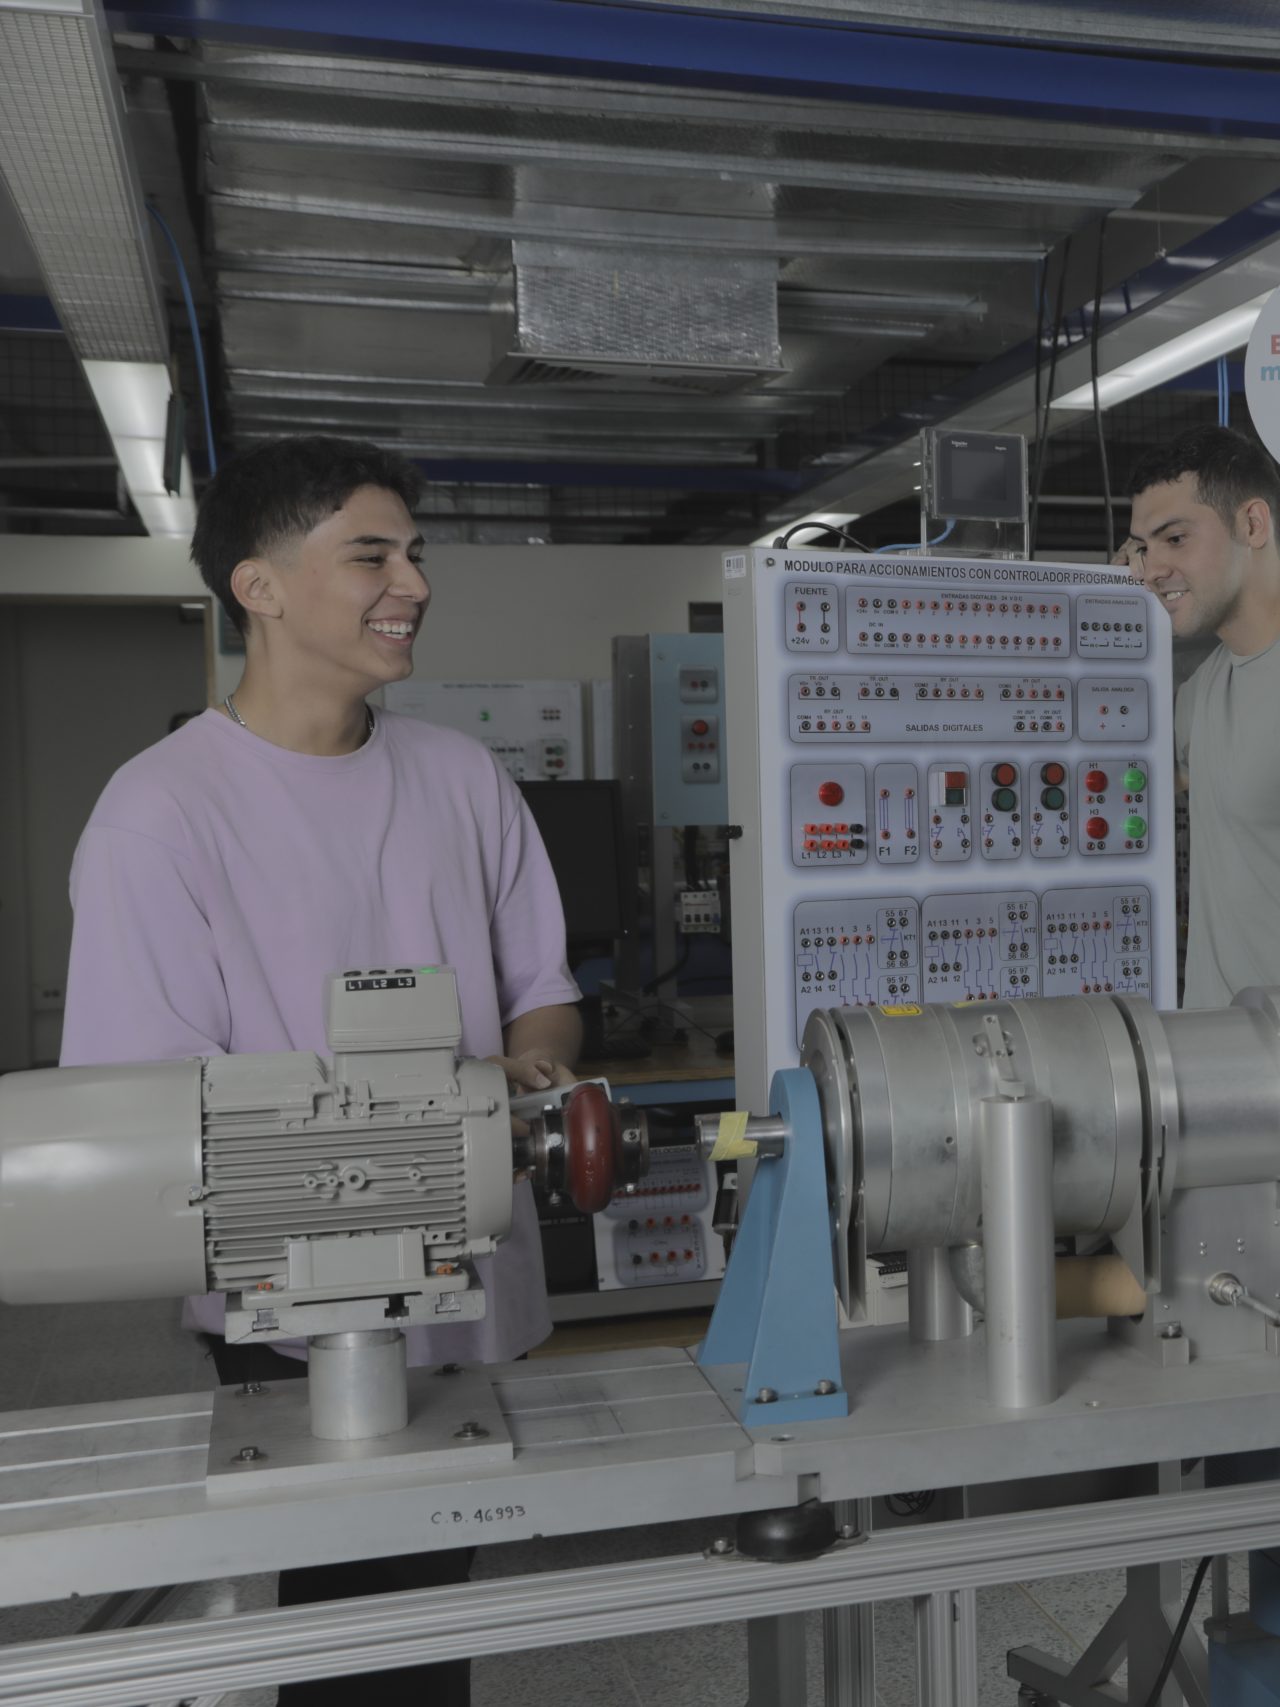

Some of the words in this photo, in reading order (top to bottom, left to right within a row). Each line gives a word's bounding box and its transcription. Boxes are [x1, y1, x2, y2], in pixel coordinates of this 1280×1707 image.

[785, 560, 833, 573] MODULO
[837, 562, 866, 575] PARA
[870, 563, 966, 580] ACCIONAMIENTOS
[969, 568, 990, 580] CON
[994, 569, 1071, 584] CONTROLADOR
[795, 587, 829, 596] FUENTE
[791, 637, 810, 645] +24v
[905, 724, 940, 732] SALIDAS
[943, 724, 984, 732] DIGITALES
[801, 851, 811, 859] L1
[879, 847, 890, 856] F1
[905, 846, 918, 855] F2
[348, 980, 362, 990] L1
[372, 979, 388, 989] L2
[398, 977, 413, 986] L3
[474, 1505, 526, 1523] 46993
